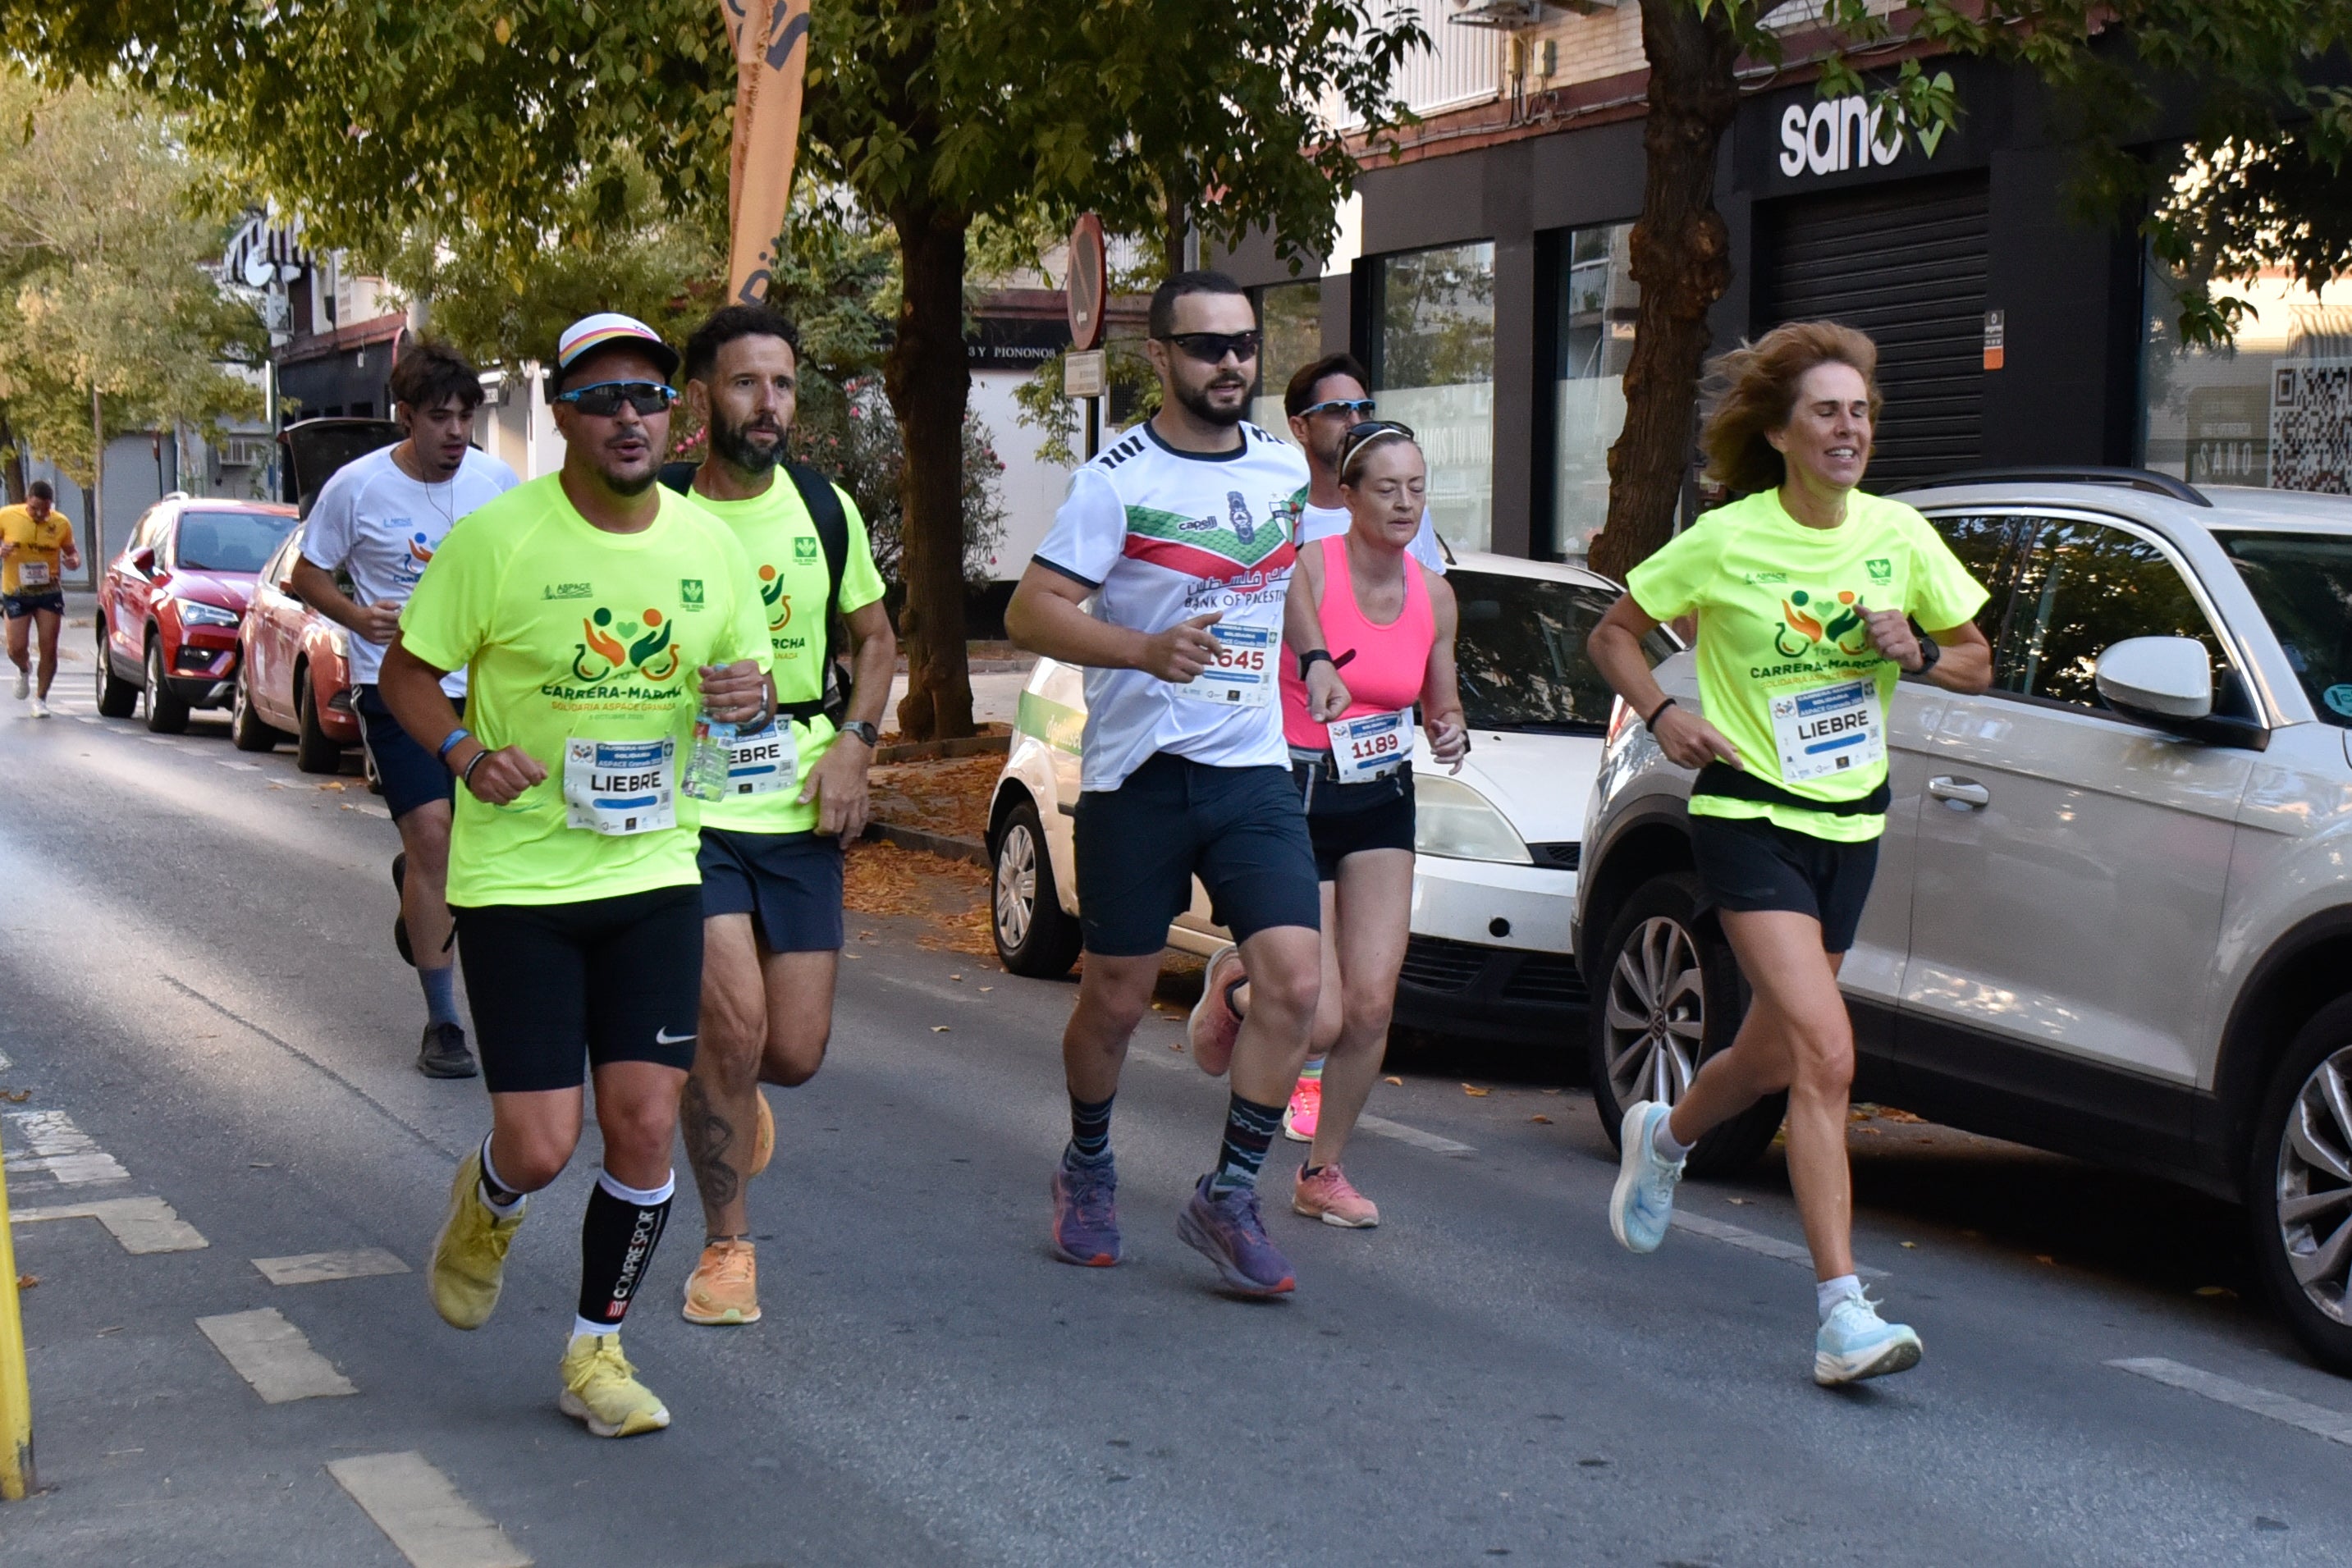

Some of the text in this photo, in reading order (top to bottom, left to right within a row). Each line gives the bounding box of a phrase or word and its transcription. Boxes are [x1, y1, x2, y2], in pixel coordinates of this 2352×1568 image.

[1779, 95, 1906, 177] sano
[994, 346, 1056, 359] PIONONOS
[2199, 441, 2252, 477] SANO
[1178, 515, 1218, 532] capelli
[557, 583, 592, 594] ASPACE
[1223, 593, 1241, 606] OF
[551, 701, 600, 711] SOLIDARIA
[602, 702, 639, 711] ASPACE
[1798, 710, 1869, 740] LIEBRE
[1352, 734, 1398, 759] 1189
[591, 770, 661, 793] LIEBRE
[613, 1209, 657, 1299] COMPRESSPOR
